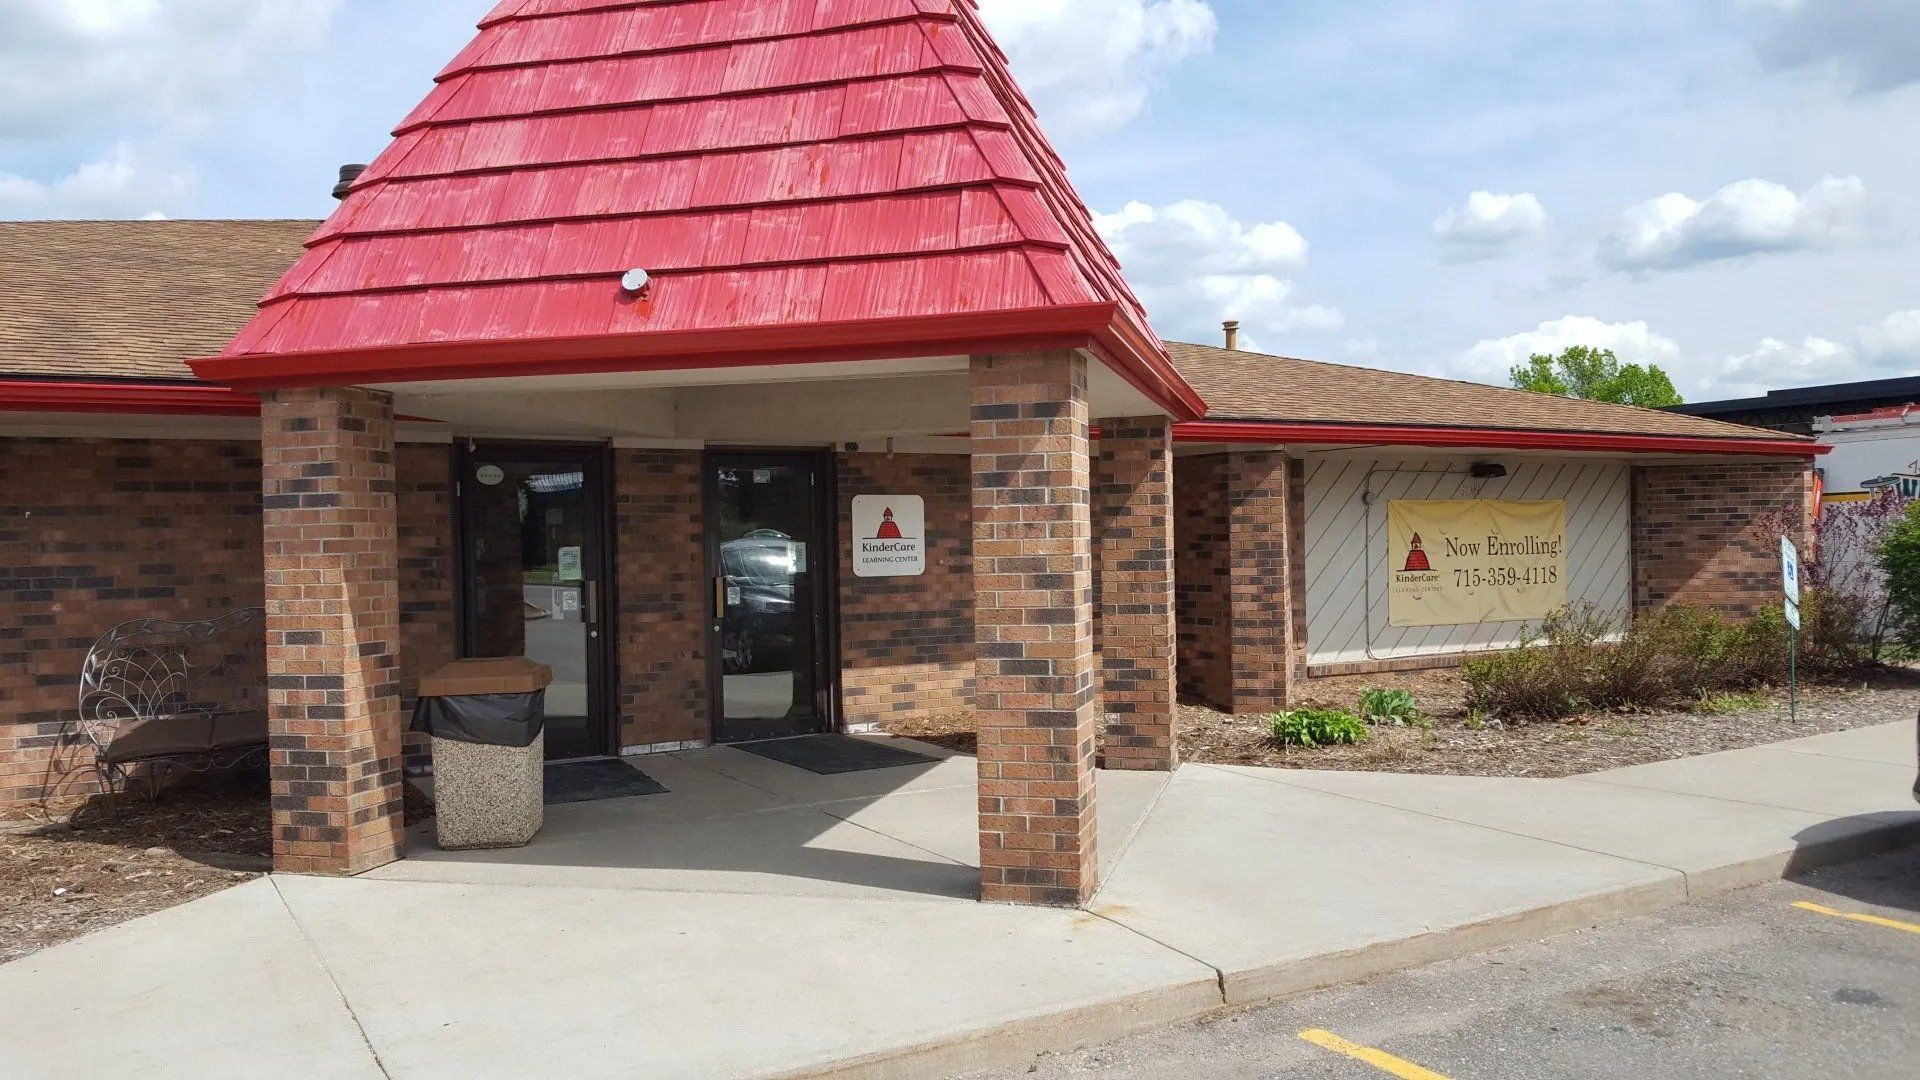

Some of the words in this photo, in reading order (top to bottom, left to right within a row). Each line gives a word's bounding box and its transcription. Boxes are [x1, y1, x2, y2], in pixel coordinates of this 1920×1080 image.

[862, 542, 916, 552] KinderCare
[1445, 536, 1480, 557] Now
[1487, 534, 1562, 559] Enrolling!
[1396, 573, 1439, 583] KinderCare
[1453, 565, 1558, 588] 715-359-4118
